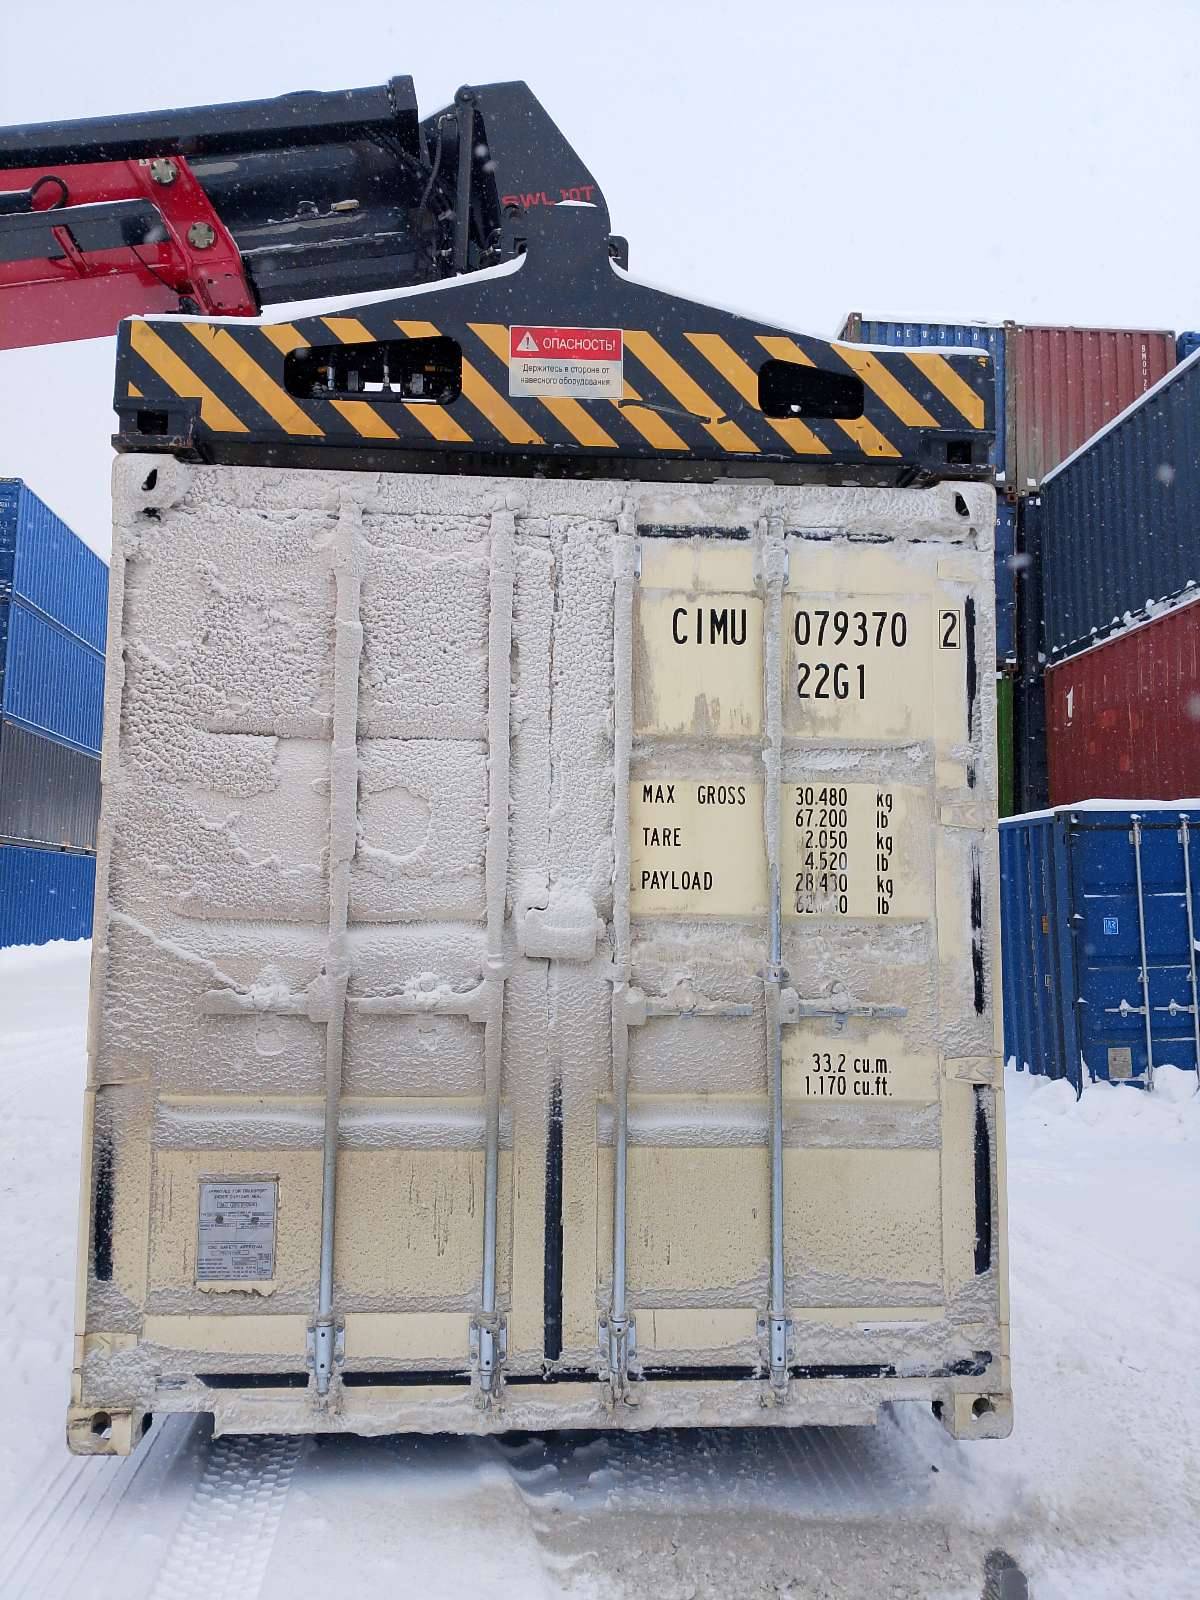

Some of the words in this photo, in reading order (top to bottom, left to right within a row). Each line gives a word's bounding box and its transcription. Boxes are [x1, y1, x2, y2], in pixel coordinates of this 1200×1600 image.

[543, 338, 616, 351] ОПАСНОСТЬ!
[522, 363, 563, 374] Держитесь
[570, 366, 600, 375] стороне
[520, 376, 557, 385] навесного
[559, 376, 611, 386] оборудования
[672, 607, 747, 646] CIMU
[795, 610, 907, 648] 079370
[942, 612, 957, 647] 2
[797, 662, 865, 700] 22G1
[643, 785, 675, 804] MAX
[697, 786, 746, 806] GROSS
[795, 787, 848, 807] 30.480
[876, 791, 893, 812] kg
[795, 809, 848, 828] 67.200
[876, 811, 889, 829] lb
[643, 828, 682, 847] TARE
[805, 830, 848, 849] 2.050
[876, 833, 893, 853] kg
[804, 852, 848, 871] 4.520
[876, 853, 889, 872] lb
[641, 870, 713, 890] PAYLOAD
[795, 873, 848, 892] 28.430
[876, 875, 894, 897] kg
[877, 897, 890, 915] lb
[812, 1053, 846, 1073] 33.2
[854, 1058, 893, 1074] cu.m.
[805, 1075, 847, 1096] 1.170
[854, 1076, 893, 1097] cu.ft.
